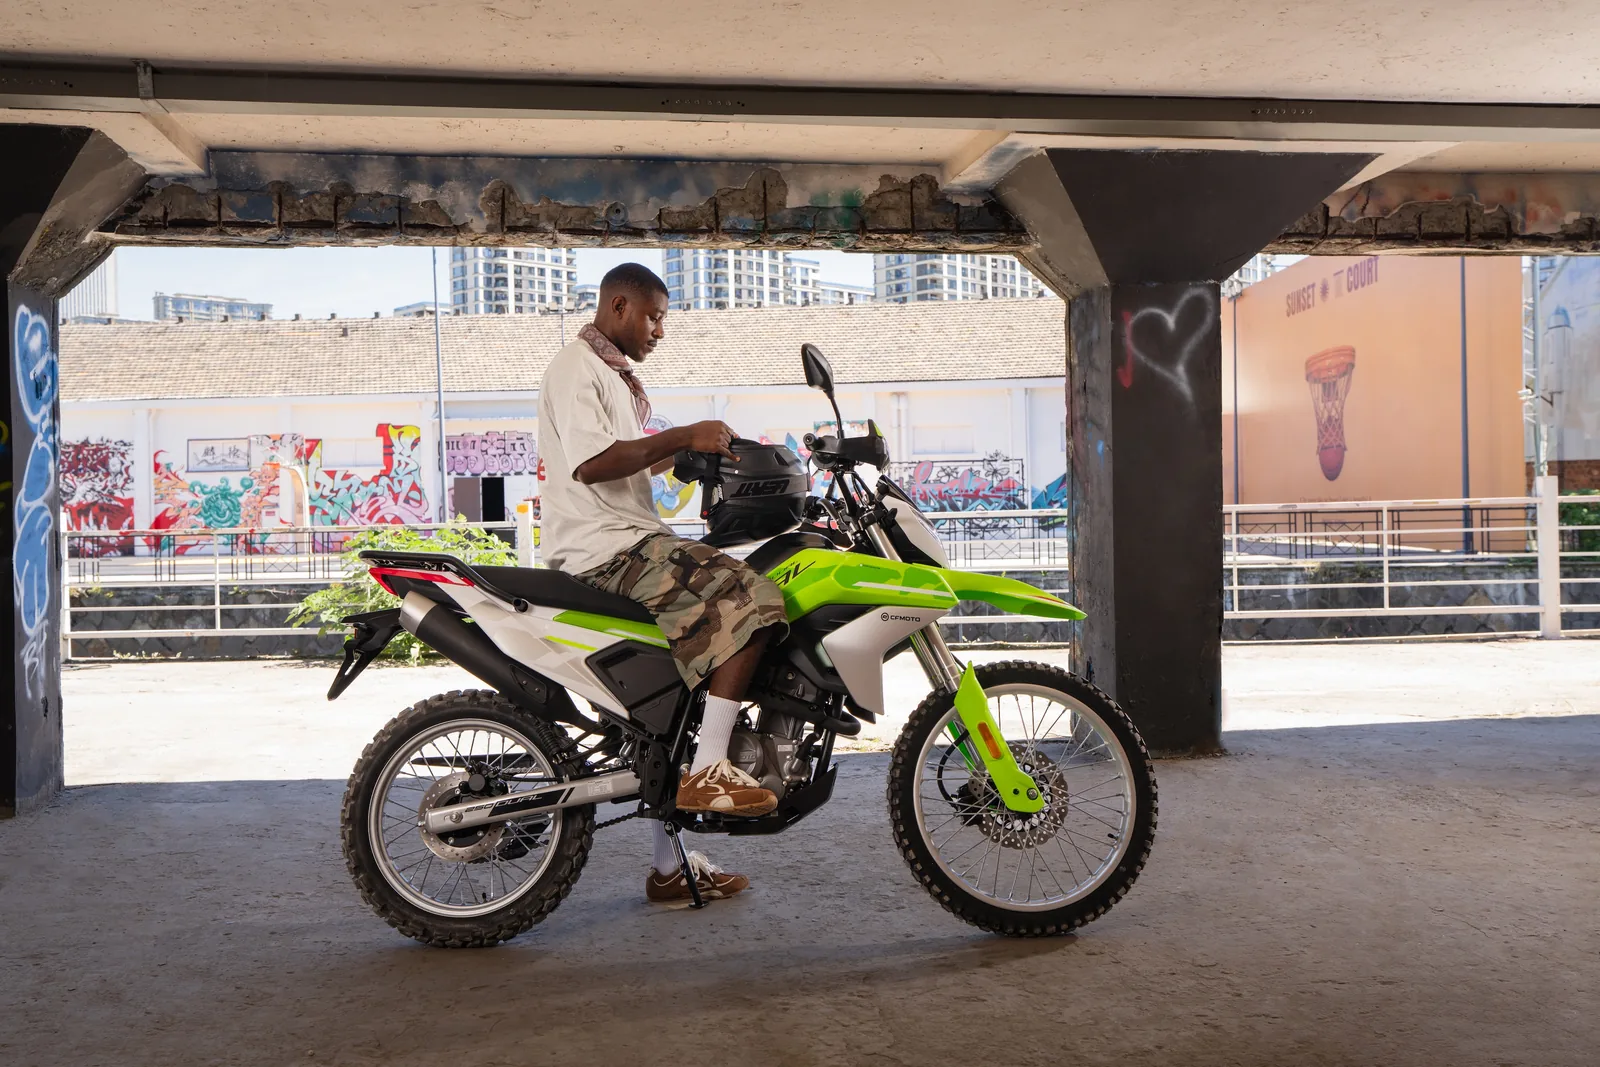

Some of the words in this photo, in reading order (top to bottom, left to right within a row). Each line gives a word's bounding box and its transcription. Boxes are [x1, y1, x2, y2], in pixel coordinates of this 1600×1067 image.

[1286, 282, 1316, 318] SUNSET
[1347, 256, 1379, 293] COURT
[890, 614, 921, 622] CFMOTO
[465, 803, 494, 812] 250
[496, 795, 542, 807] DUAL
